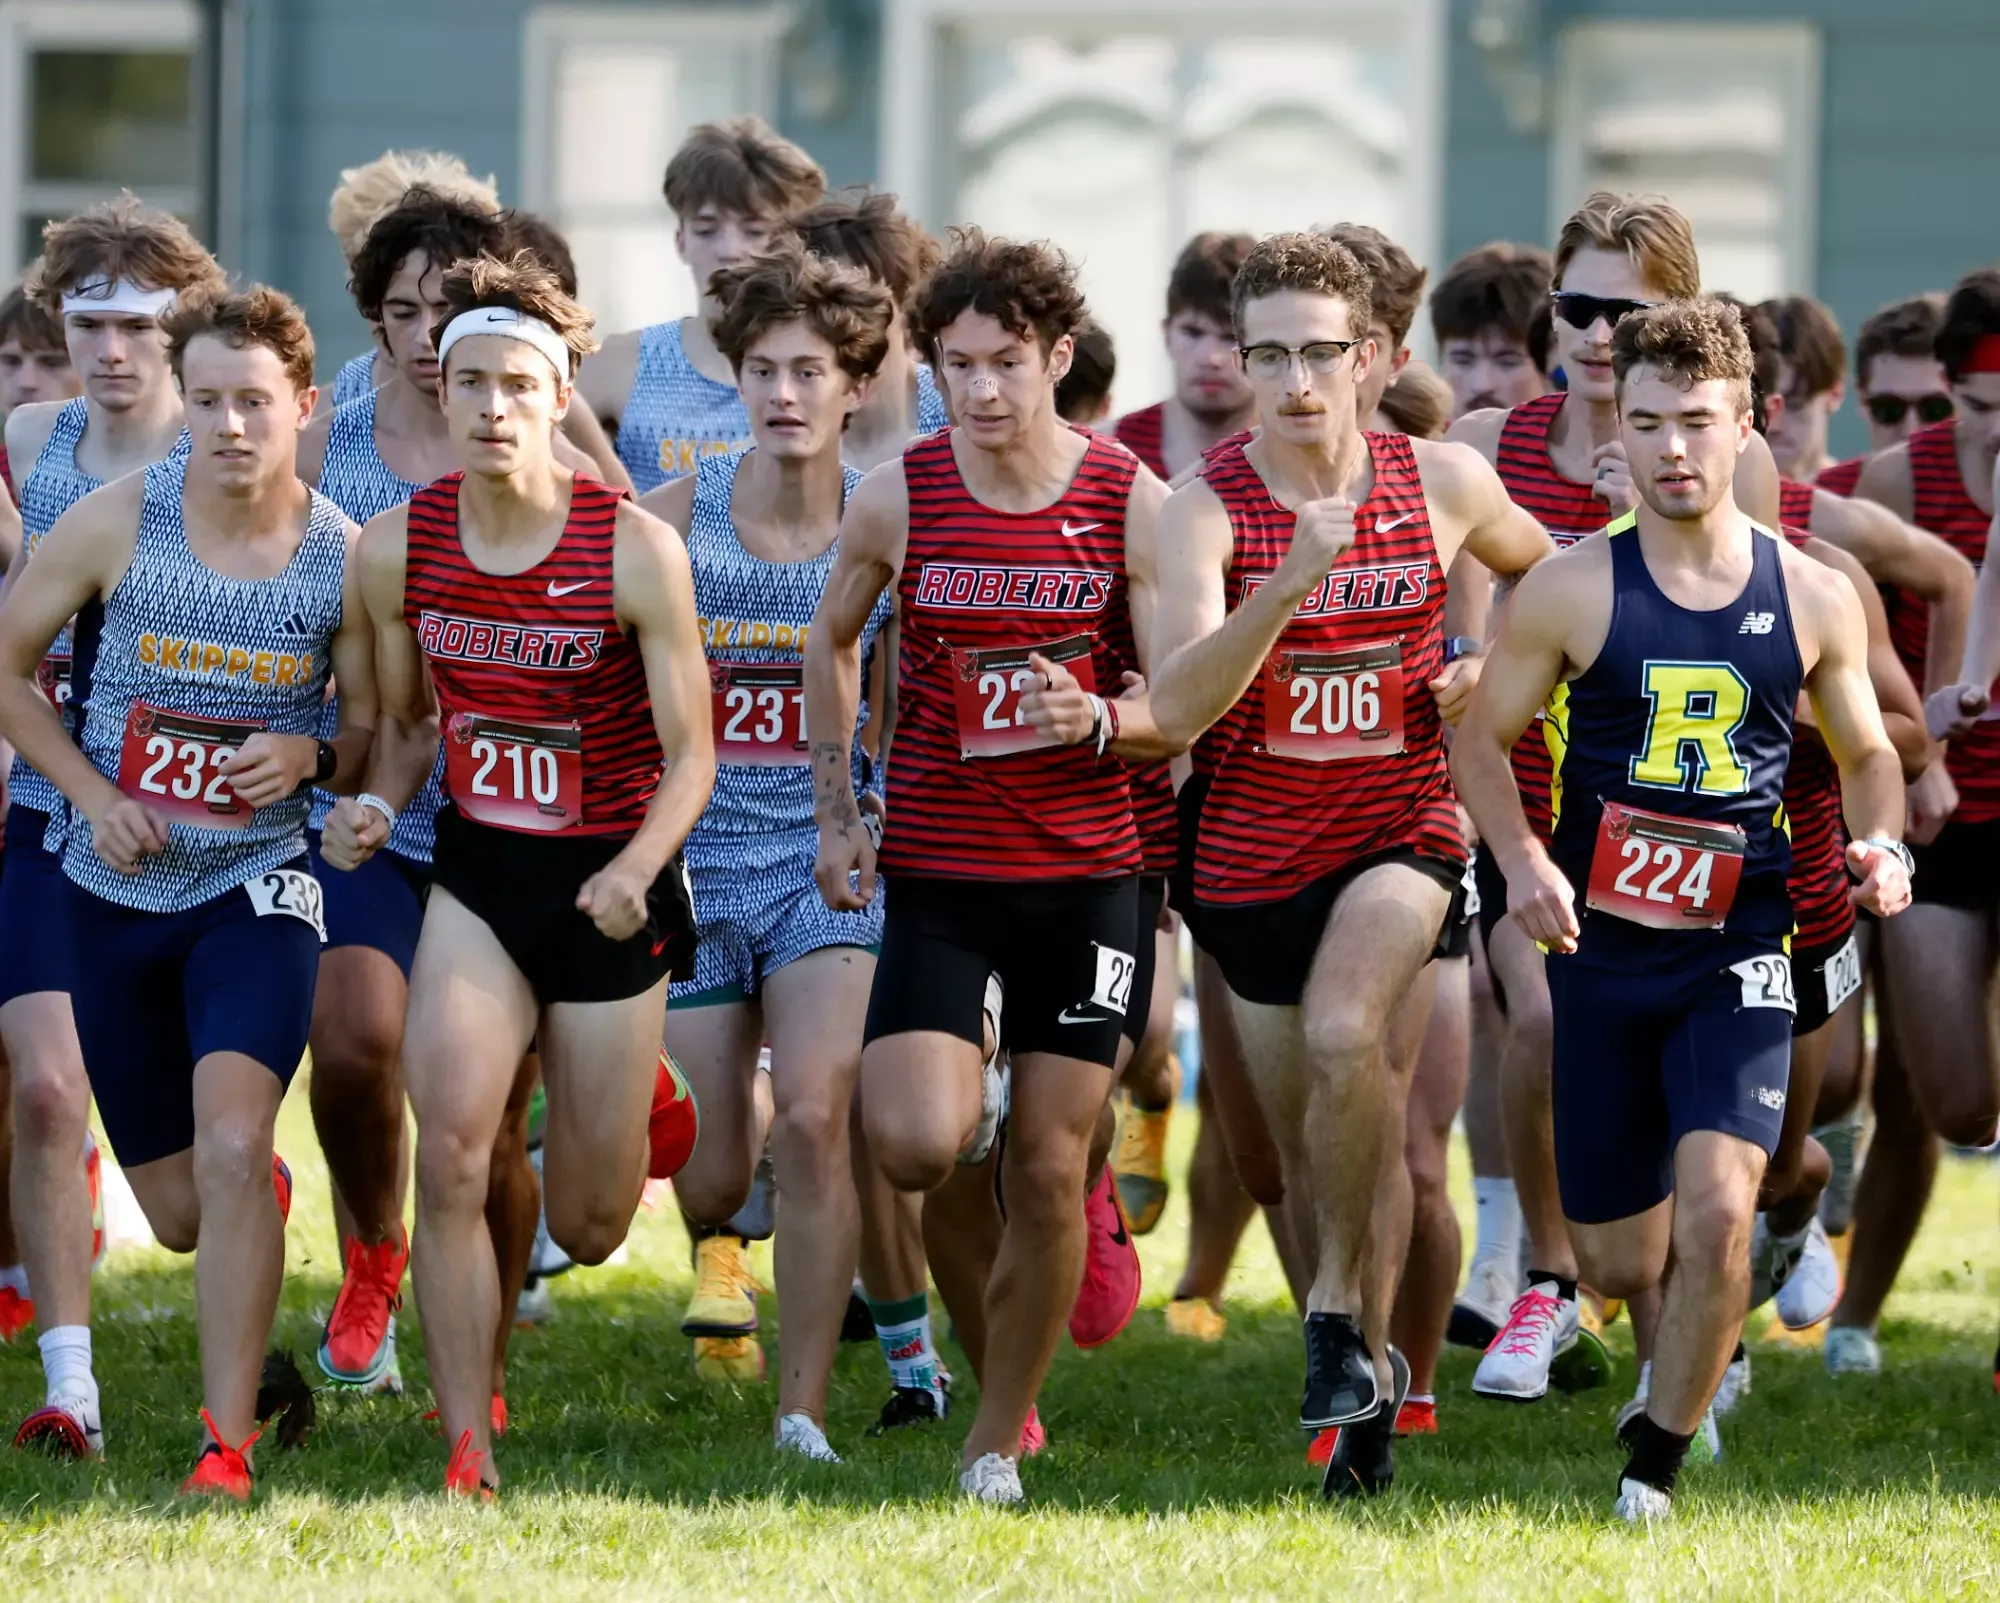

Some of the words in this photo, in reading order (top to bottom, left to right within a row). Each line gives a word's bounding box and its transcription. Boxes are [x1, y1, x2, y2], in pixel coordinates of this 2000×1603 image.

[917, 565, 1112, 611] ROBERTS
[1241, 562, 1429, 617] BERTS
[139, 633, 313, 686] SKIPPERS
[419, 613, 603, 669] ROBERTS
[724, 688, 808, 743] 231
[1290, 672, 1380, 735] 206
[1628, 660, 1751, 796] R
[139, 736, 239, 804] 232
[471, 740, 559, 804] 210
[263, 874, 319, 928] 232
[1614, 838, 1714, 908] 224
